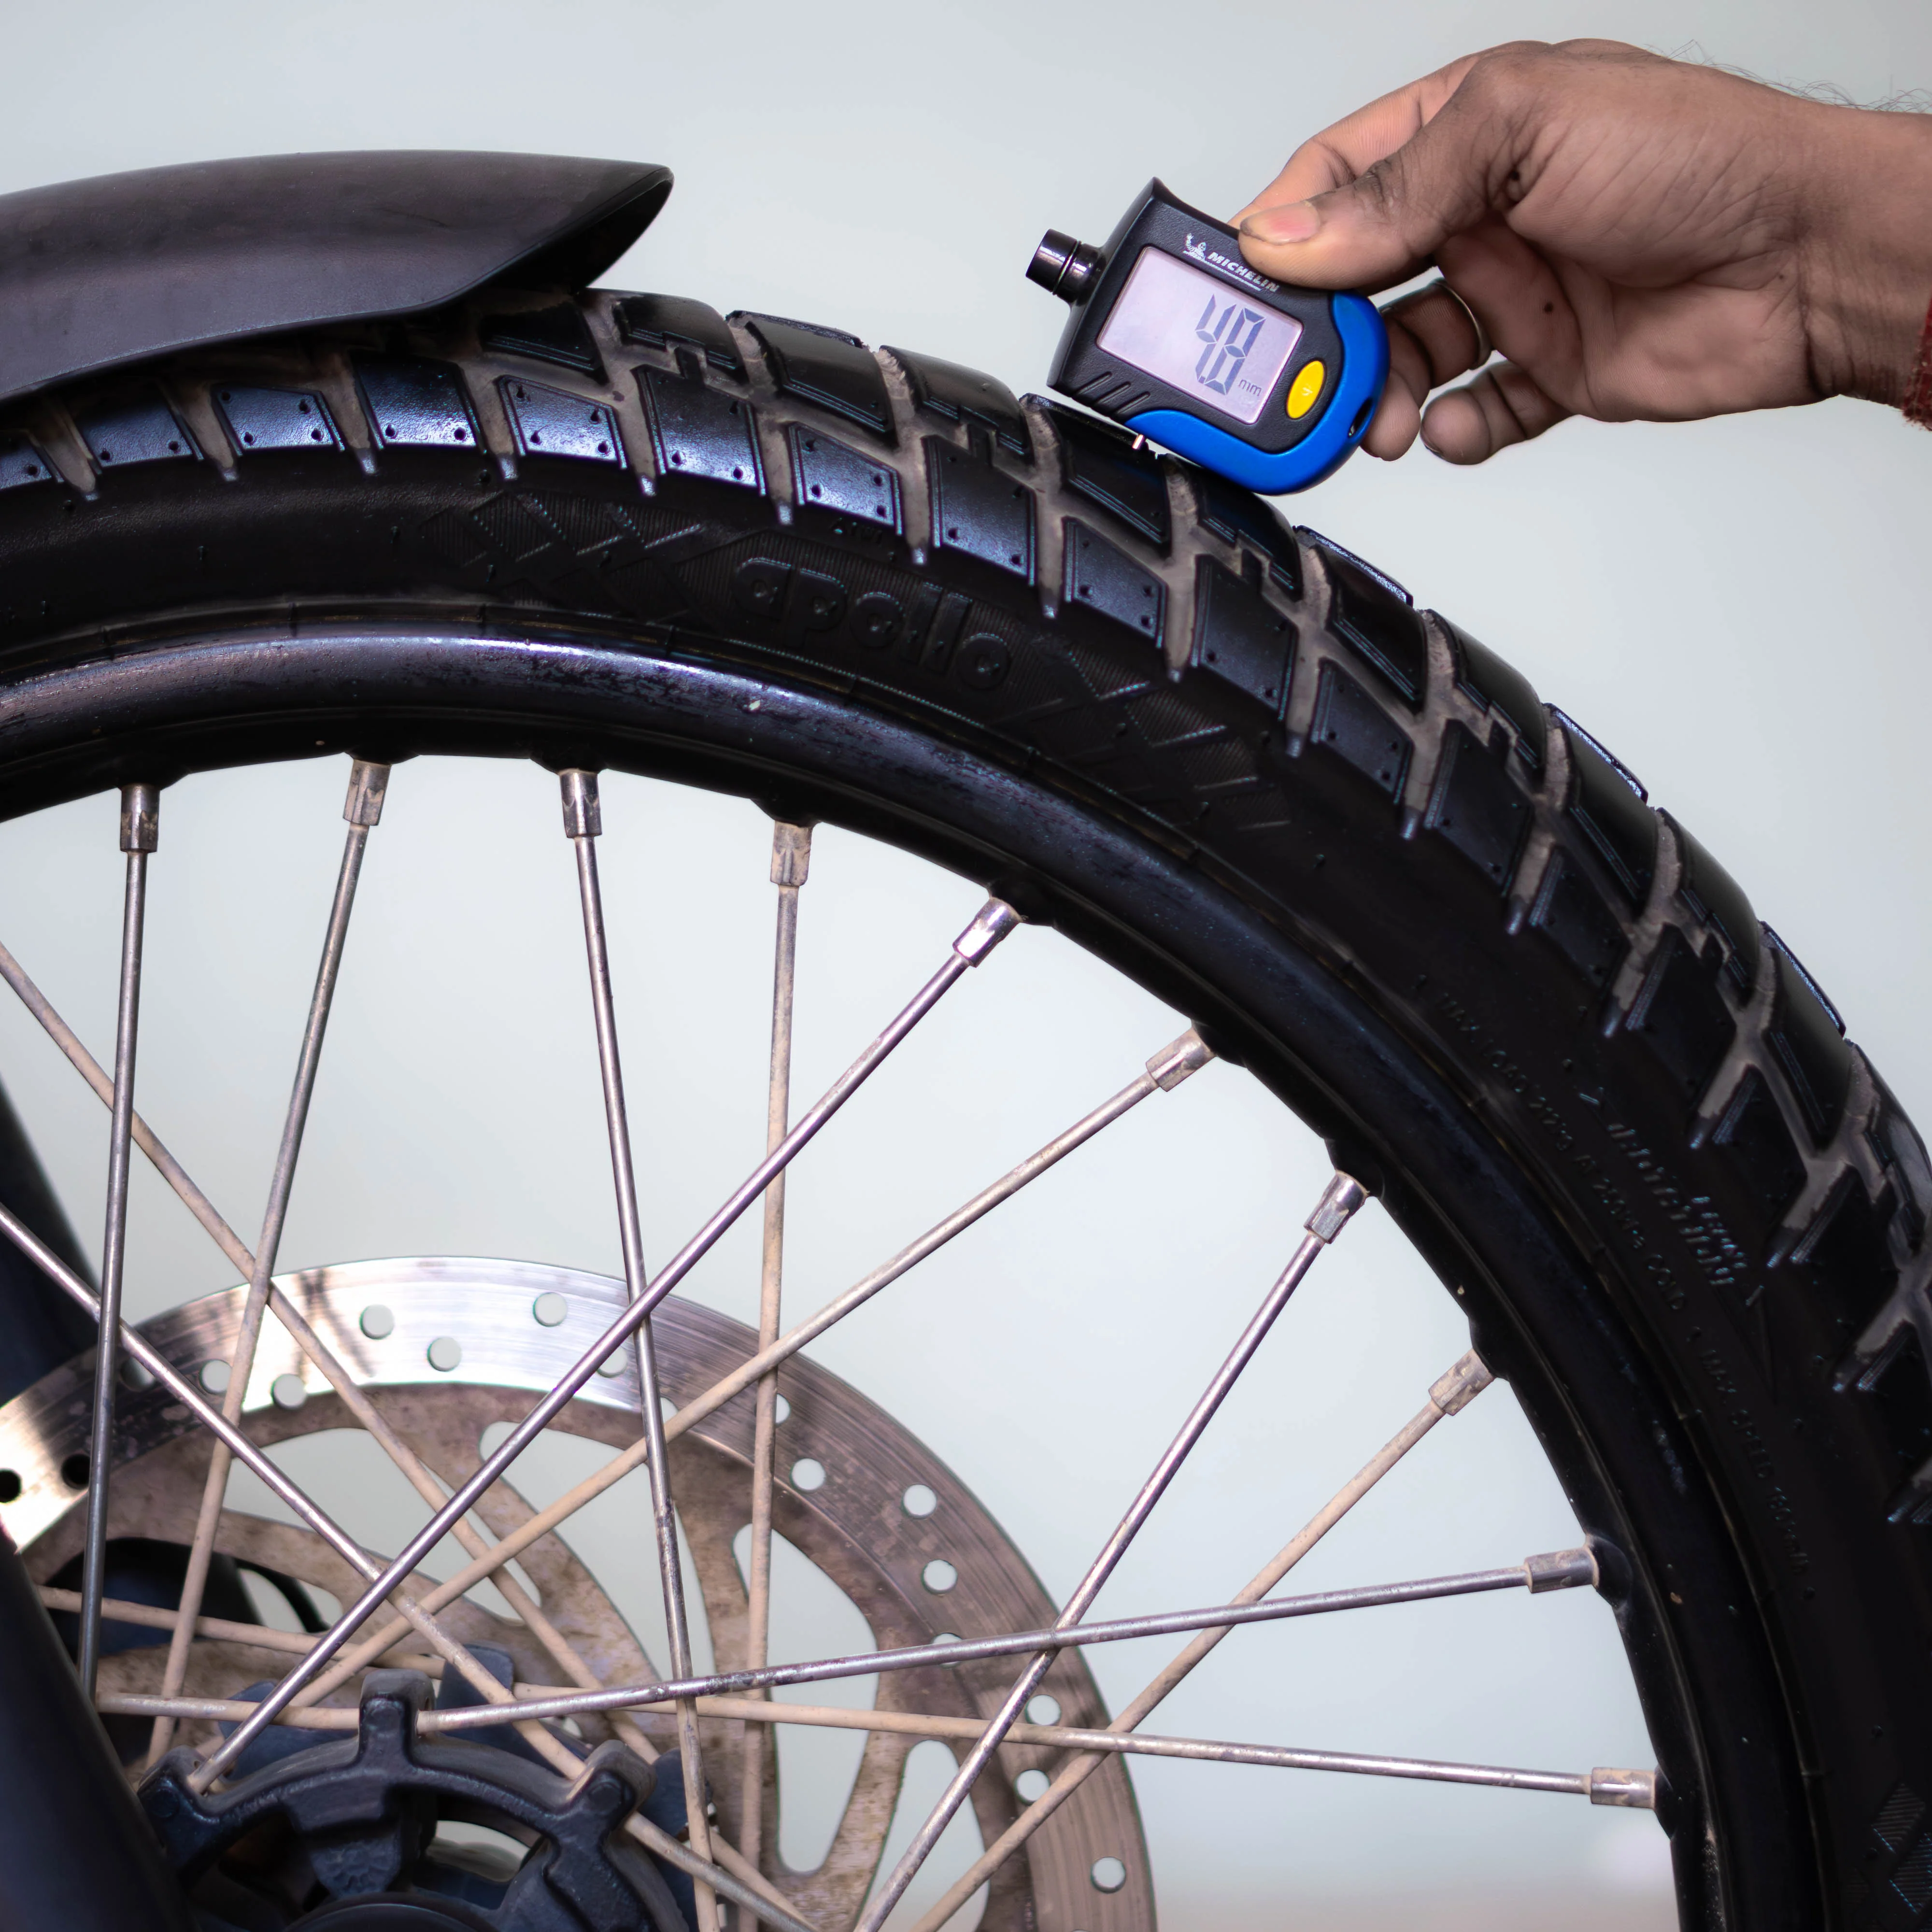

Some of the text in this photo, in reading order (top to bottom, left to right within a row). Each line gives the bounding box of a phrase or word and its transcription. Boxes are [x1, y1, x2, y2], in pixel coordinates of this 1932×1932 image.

[1208, 252, 1279, 292] MICHELIN
[1238, 379, 1262, 397] mm
[730, 556, 1011, 691] apollo
